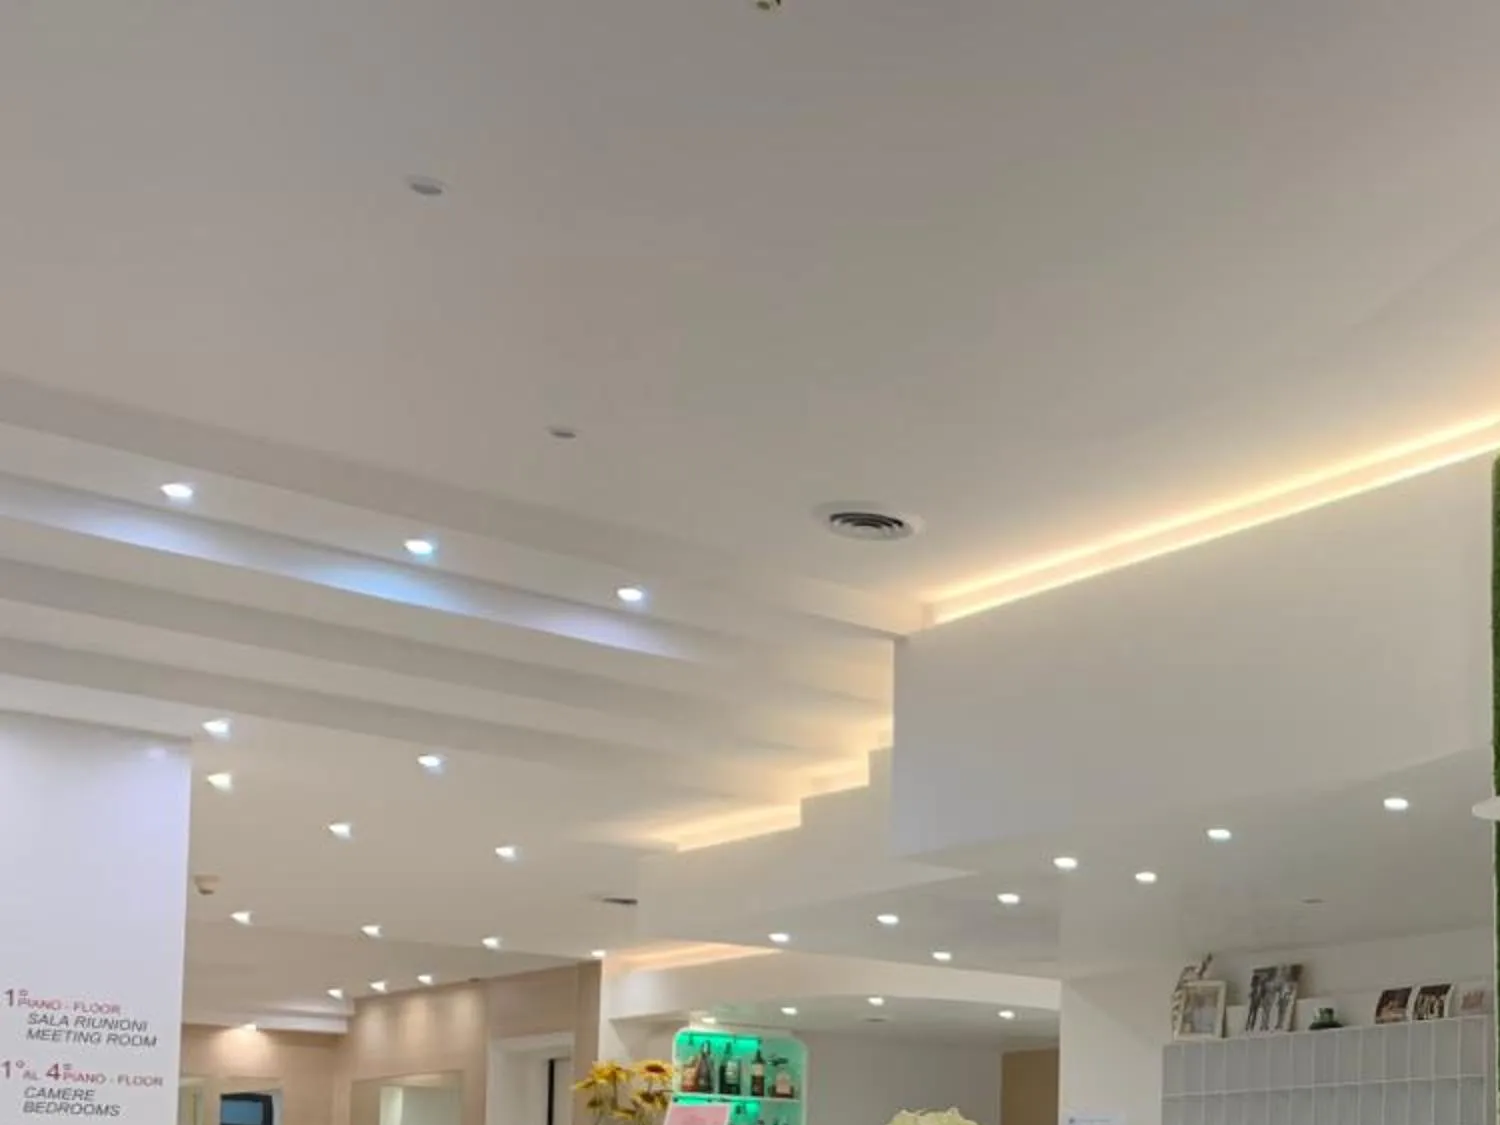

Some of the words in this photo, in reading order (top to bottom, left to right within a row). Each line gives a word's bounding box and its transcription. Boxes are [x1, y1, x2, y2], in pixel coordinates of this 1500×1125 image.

[18, 998, 62, 1012] PIANO
[73, 1001, 121, 1015] FLOOR
[27, 1012, 69, 1027] SALA
[74, 1015, 148, 1033] RIUNIONI
[26, 1029, 102, 1045] MEETING
[106, 1033, 157, 1048] ROOM
[23, 1070, 39, 1081] AL
[62, 1070, 107, 1084] PIANO
[117, 1074, 163, 1087] FLOOR
[24, 1086, 96, 1101] CAMERE
[23, 1101, 120, 1117] BEDROOMS
